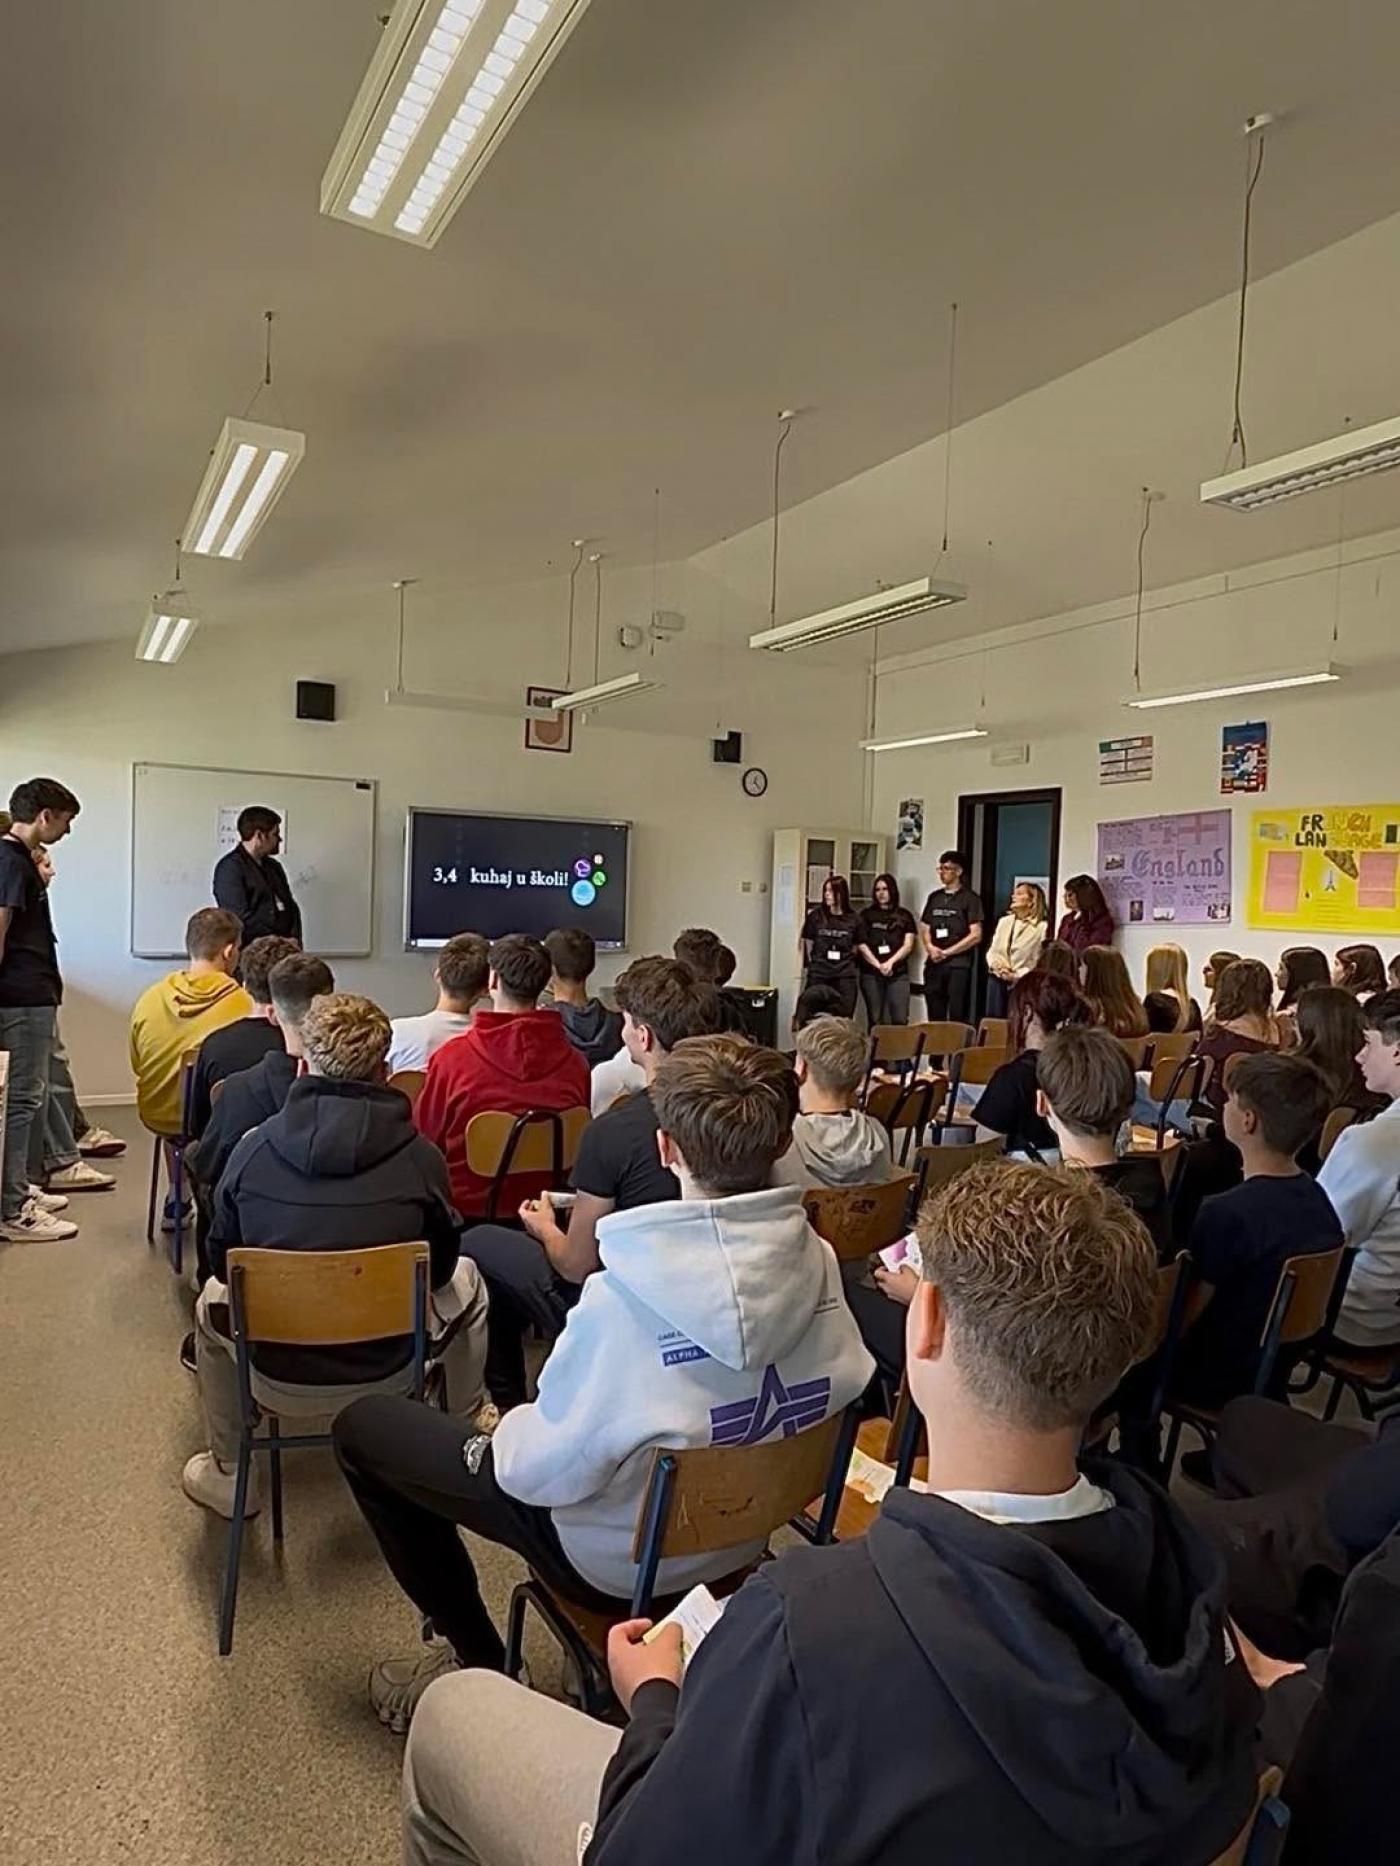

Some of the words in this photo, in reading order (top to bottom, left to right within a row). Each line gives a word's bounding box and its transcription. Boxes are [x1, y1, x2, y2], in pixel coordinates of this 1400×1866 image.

[1131, 848, 1224, 879] England
[433, 867, 457, 884] 3,4
[469, 867, 512, 888] kuhaj
[516, 873, 526, 885] u
[529, 870, 569, 887] školi!
[665, 1349, 700, 1363] ALPHA
